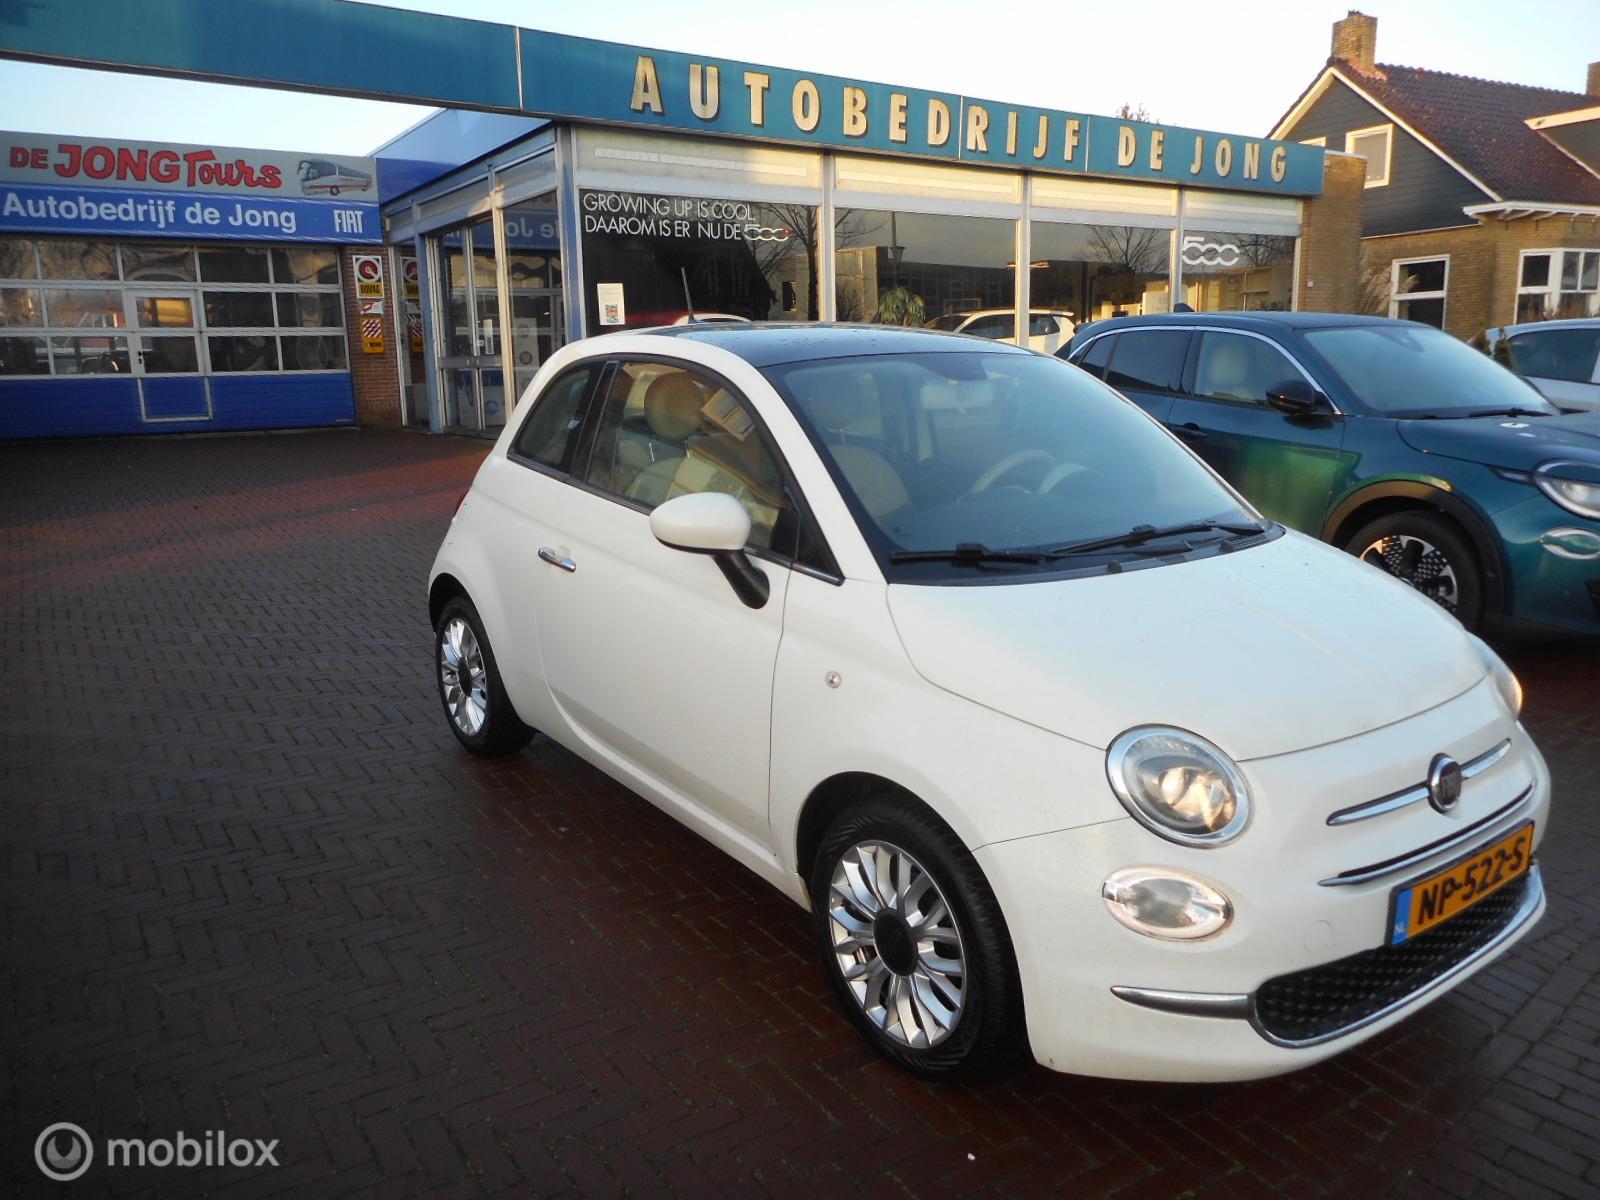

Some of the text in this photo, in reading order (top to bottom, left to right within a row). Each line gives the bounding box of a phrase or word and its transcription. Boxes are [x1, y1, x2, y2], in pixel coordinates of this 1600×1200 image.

[630, 55, 1287, 183] AUTOBEDRIJF DE JONG
[10, 144, 283, 189] DE JONG Tours
[2, 192, 297, 233] Autobedrijf de Jong
[333, 209, 363, 234] FIAT
[583, 193, 670, 216] GROWING
[674, 199, 693, 217] UP
[697, 201, 709, 218] IS
[585, 215, 790, 242] DAAROM IS ER NU DE 500
[1182, 236, 1240, 266] 500
[1417, 836, 1526, 925] NP-522-S
